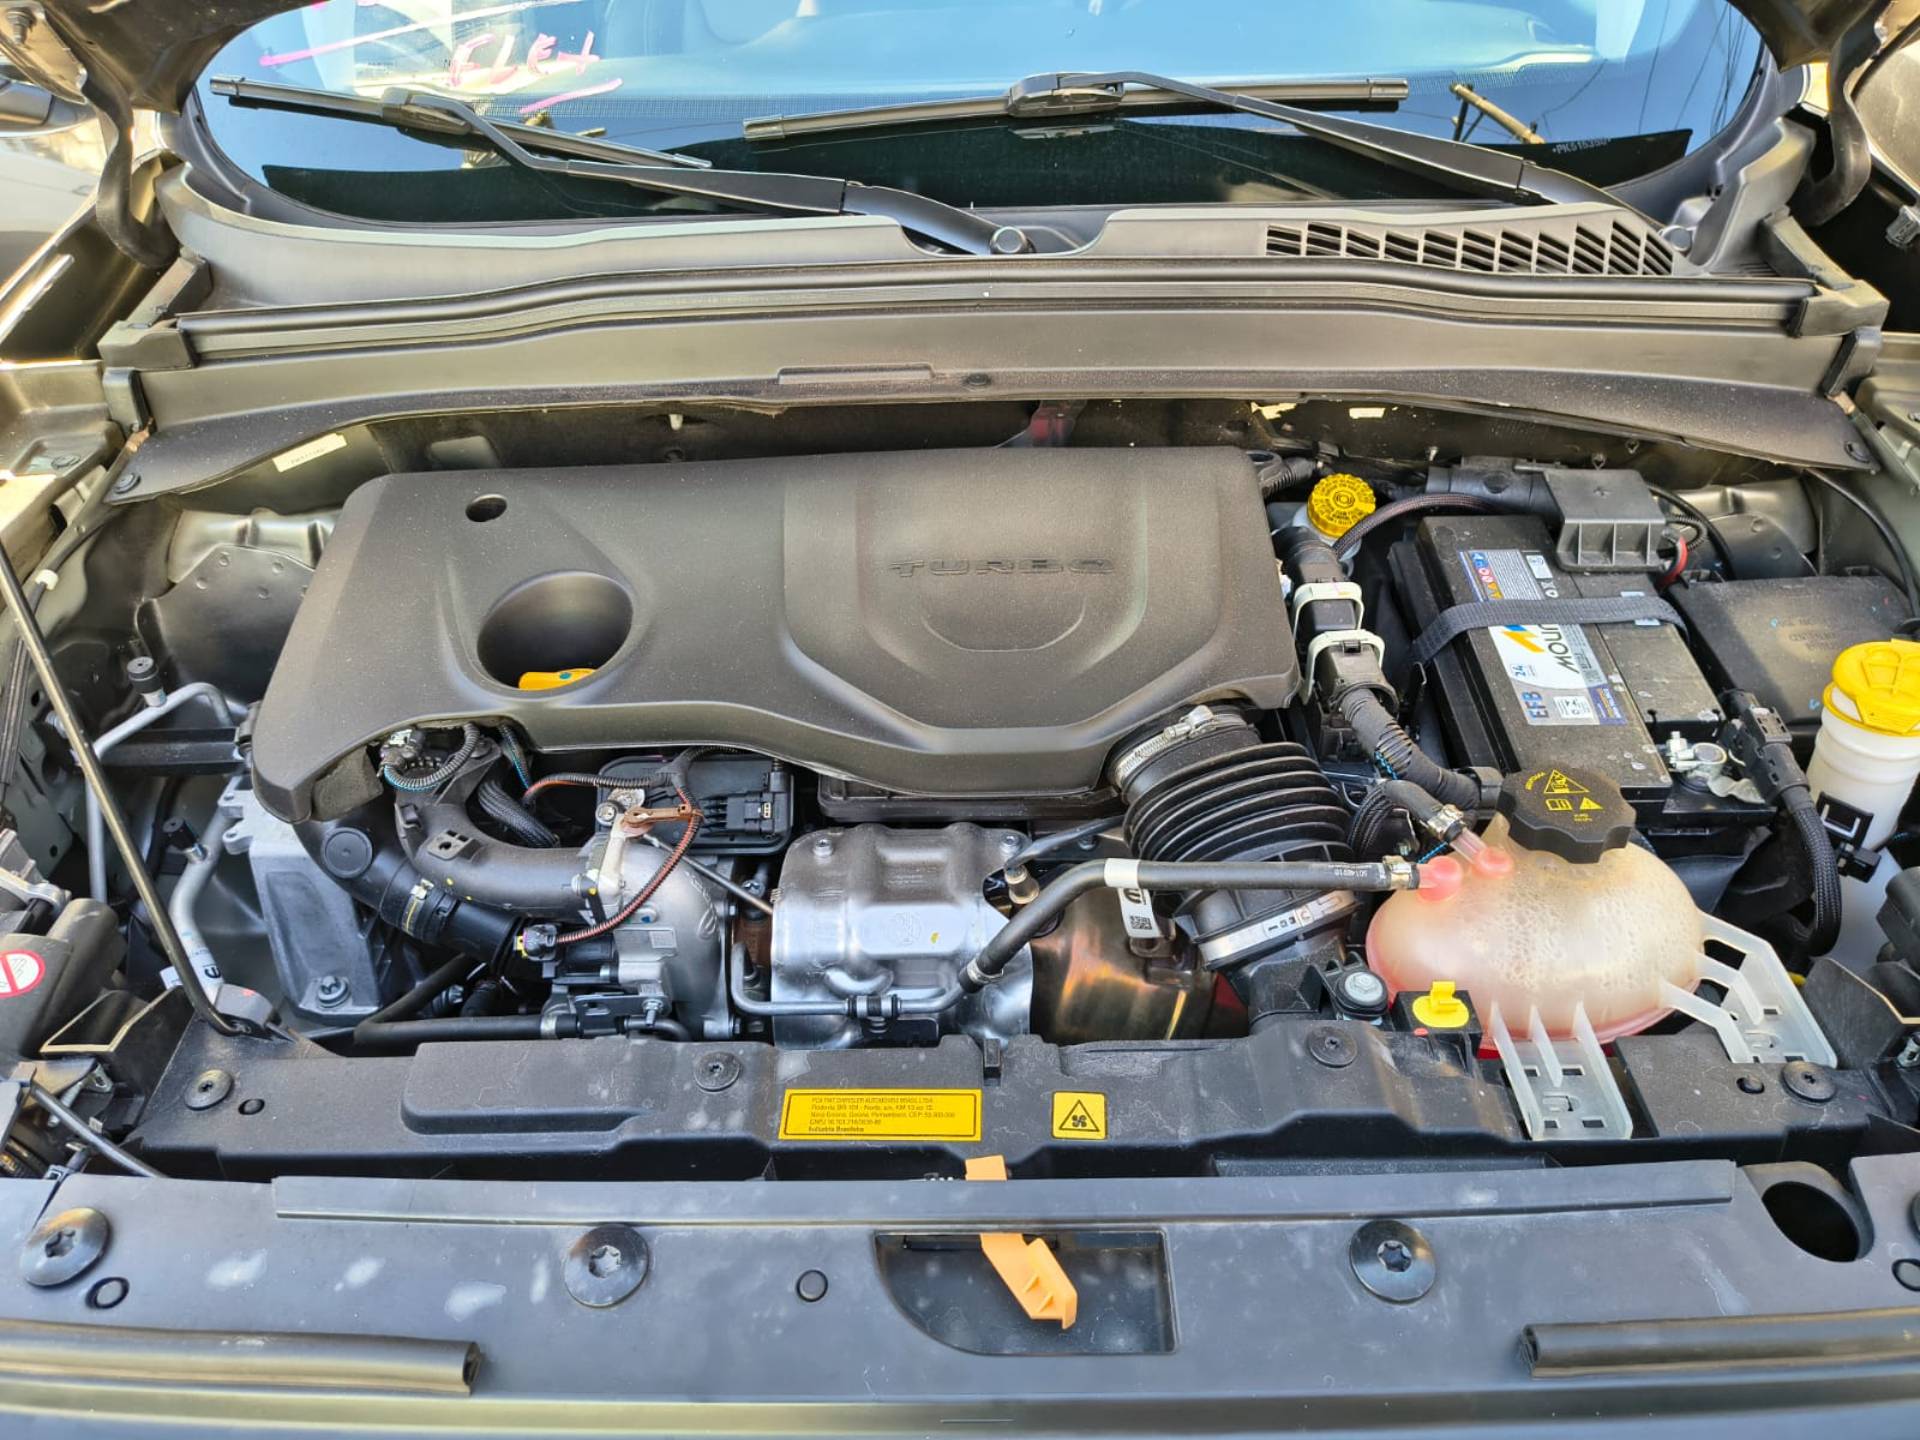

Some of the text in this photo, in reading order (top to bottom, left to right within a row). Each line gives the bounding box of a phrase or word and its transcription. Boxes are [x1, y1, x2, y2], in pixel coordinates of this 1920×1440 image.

[449, 30, 601, 87] FLEX
[888, 557, 1113, 578] TURBO
[1522, 691, 1549, 718] EFB
